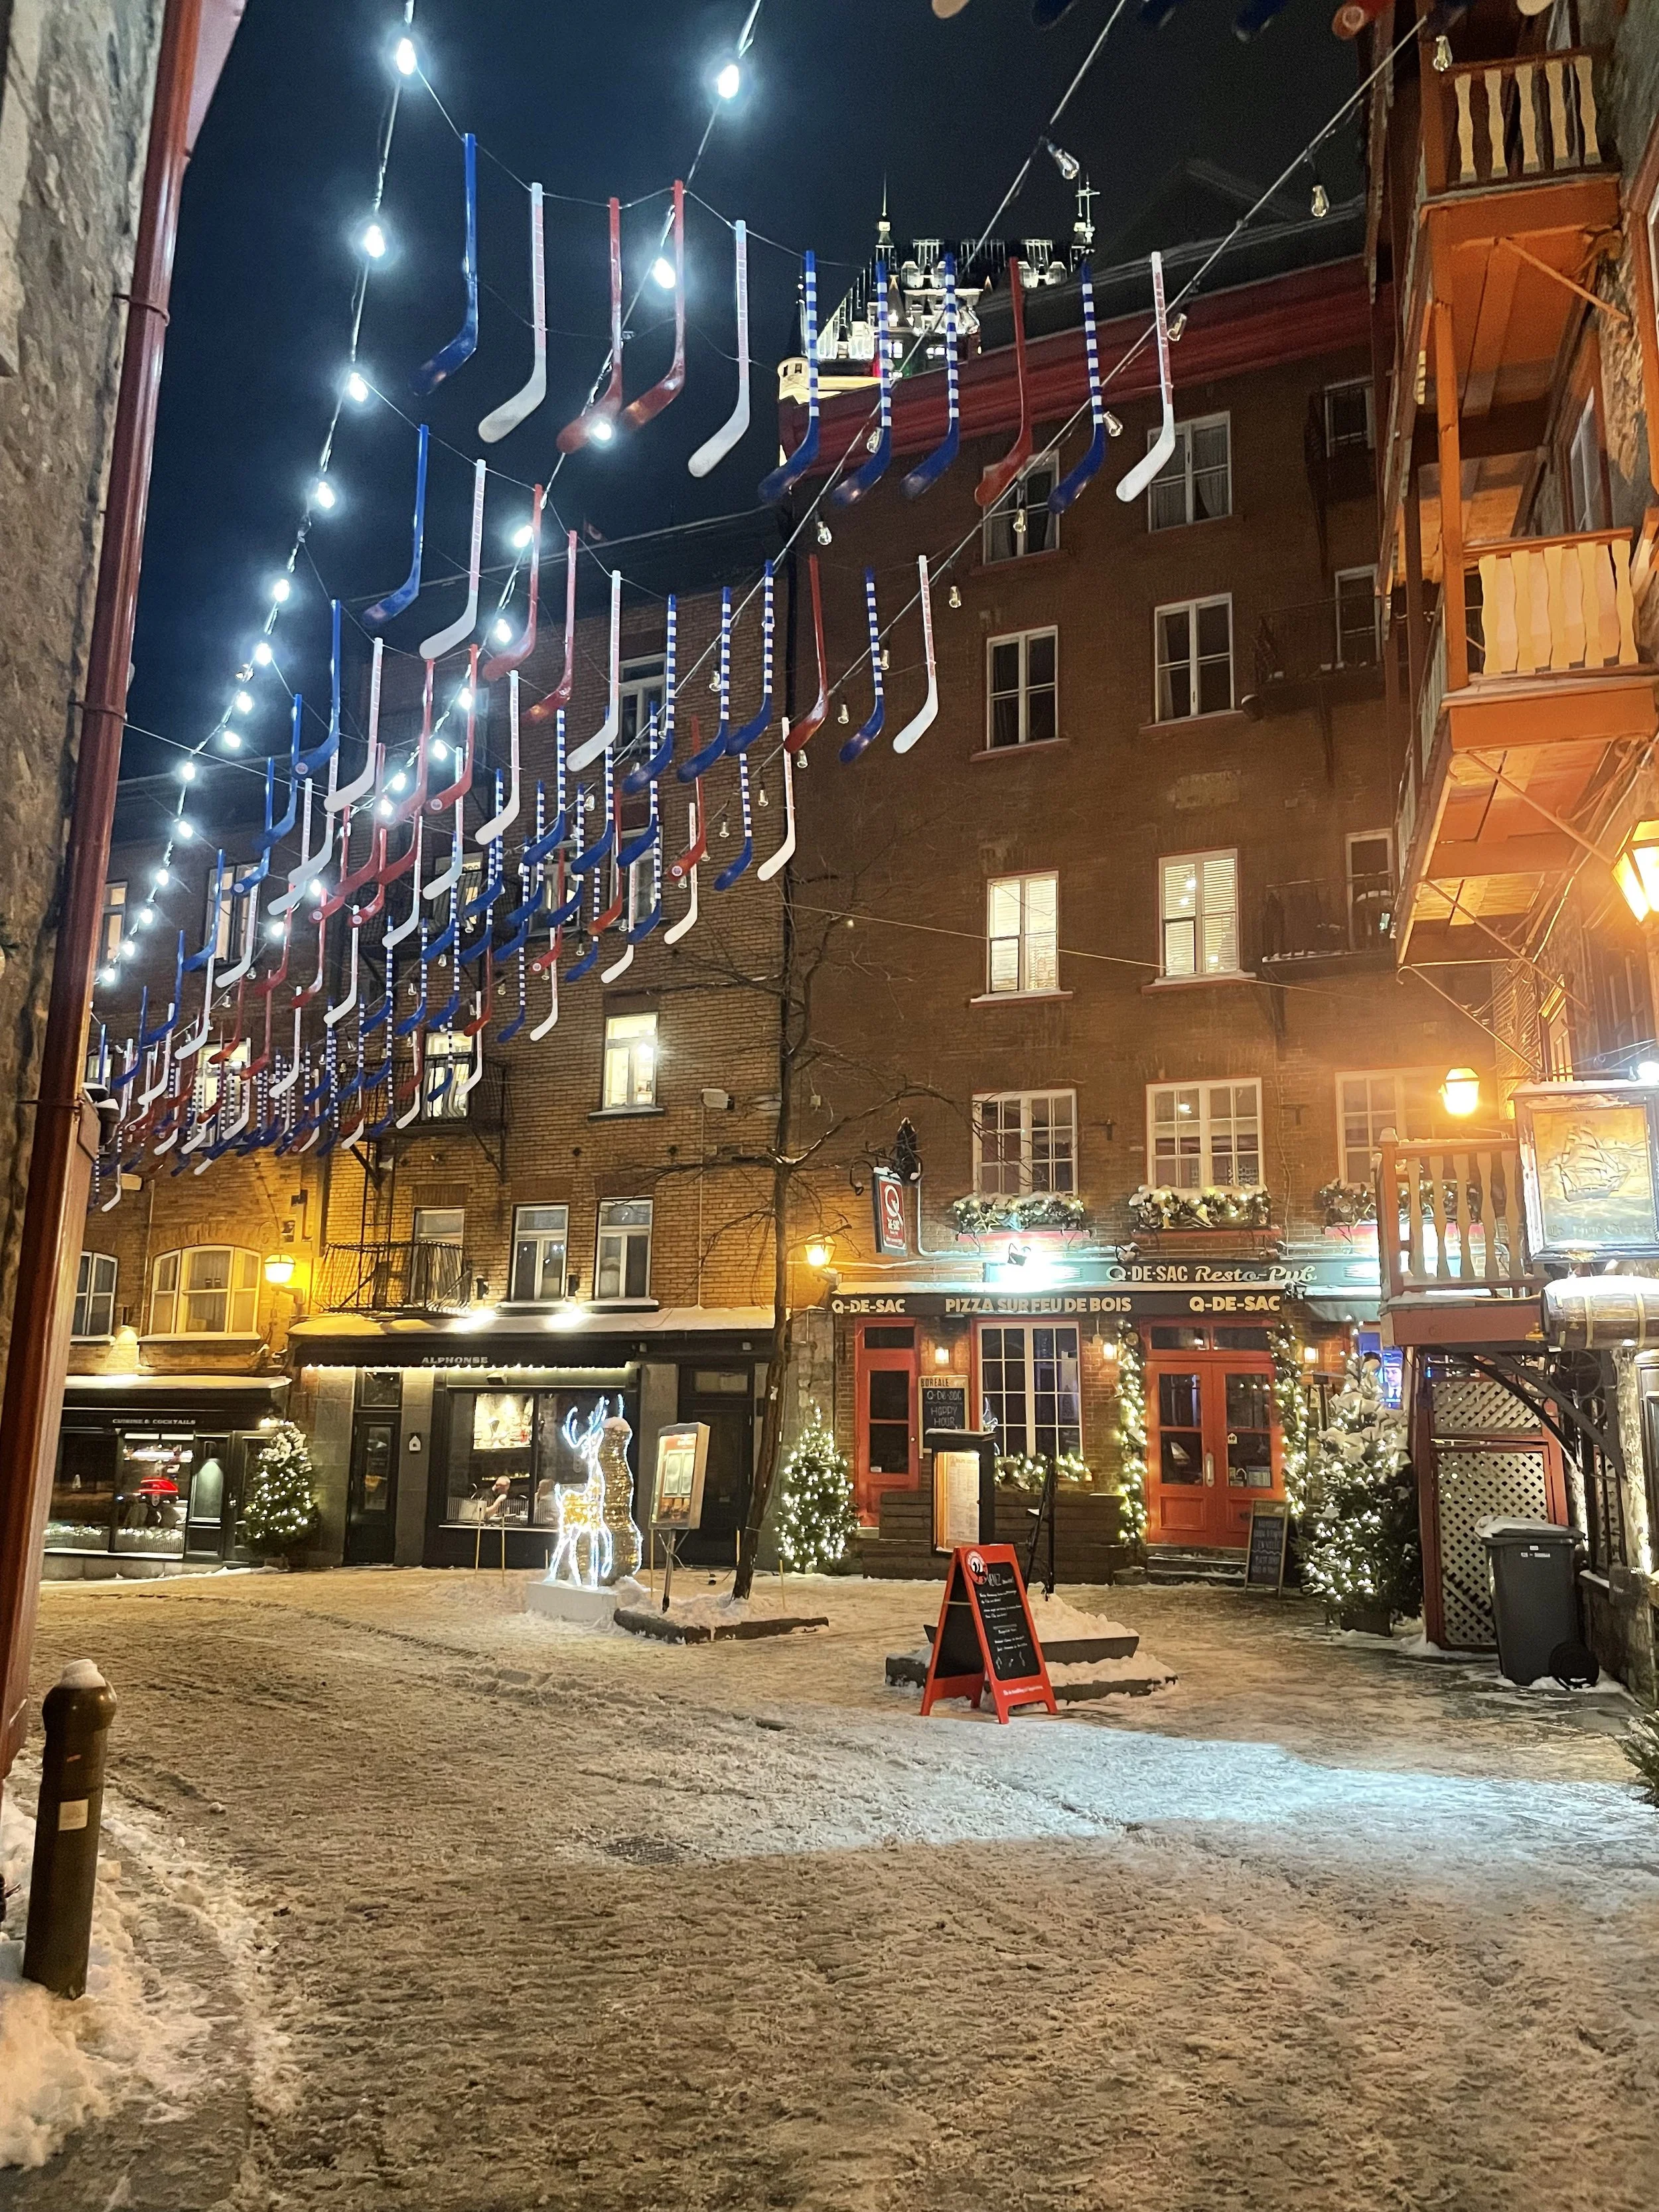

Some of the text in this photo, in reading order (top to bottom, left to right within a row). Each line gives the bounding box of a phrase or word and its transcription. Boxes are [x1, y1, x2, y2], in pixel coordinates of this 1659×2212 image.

[831, 1298, 906, 1314] Q-DE-SAC
[945, 1297, 1132, 1313] PIZZA SUR FEU DE BOIS
[1189, 1295, 1281, 1312] Q-DE-SAC
[934, 1417, 955, 1427] HOUR
